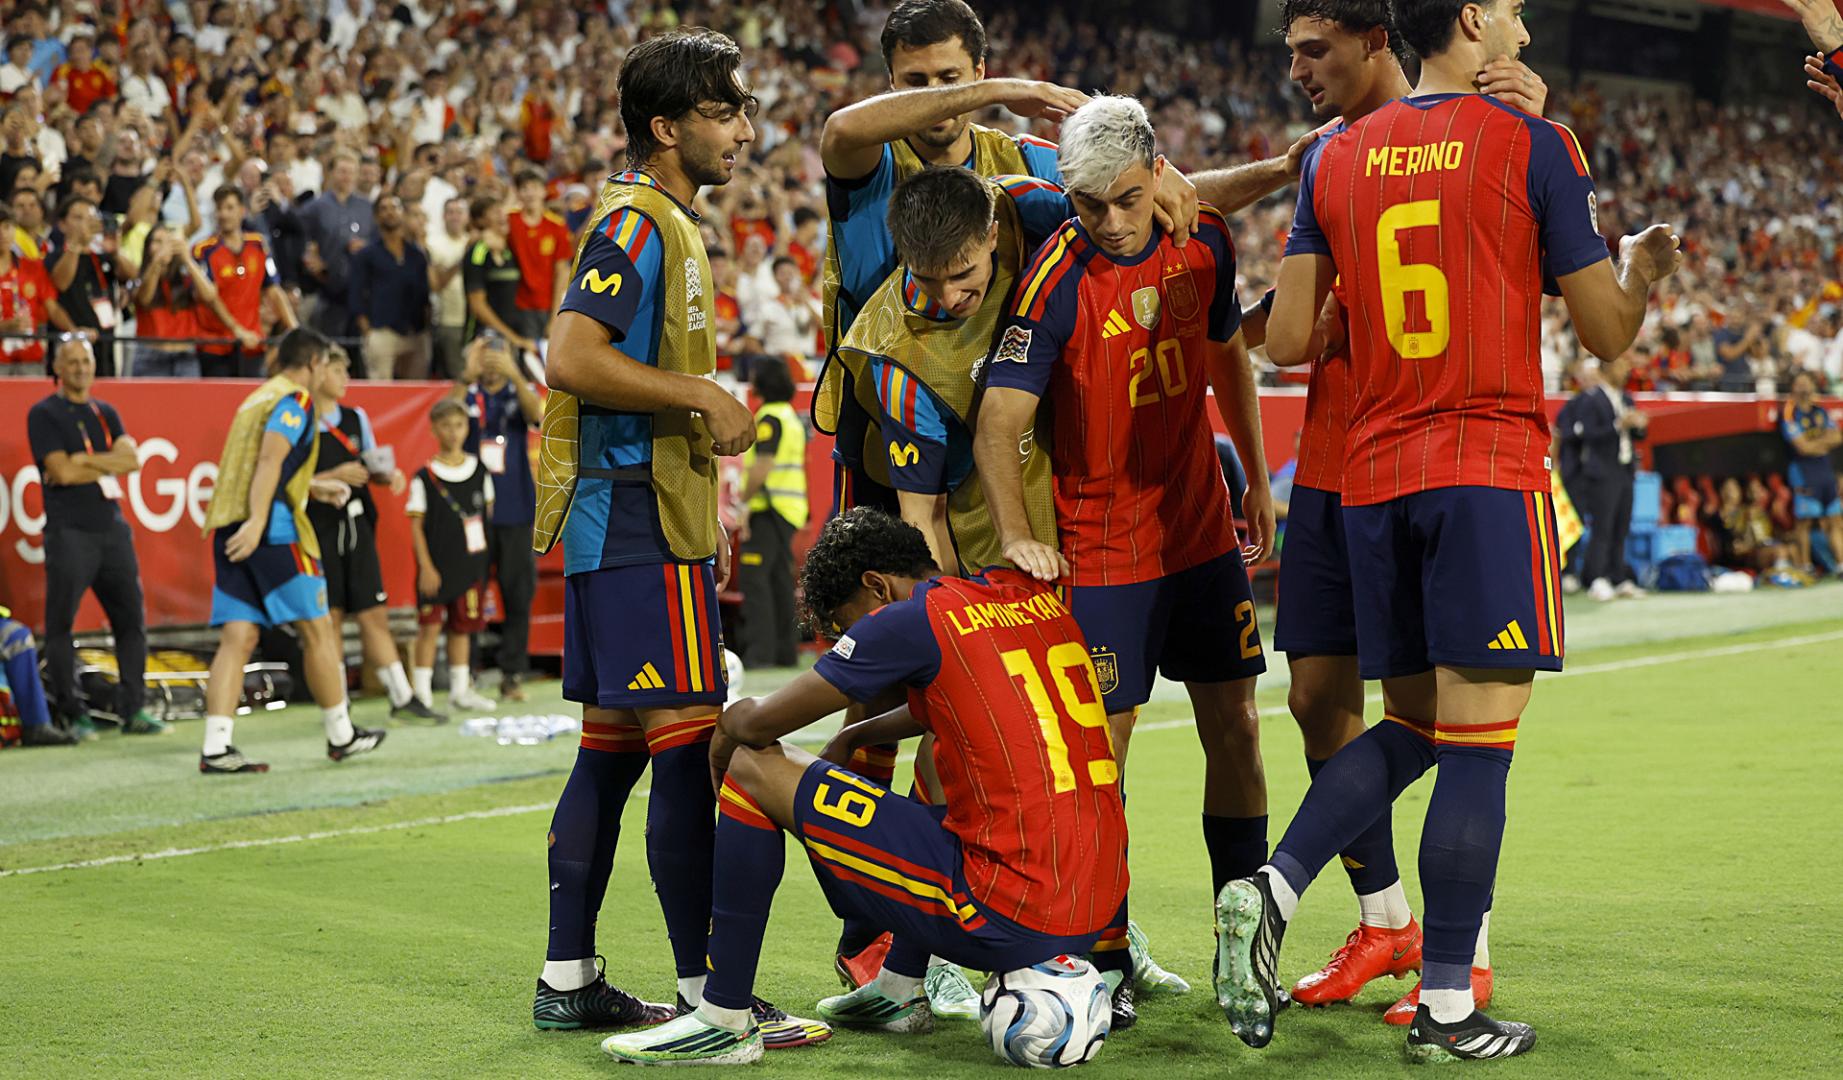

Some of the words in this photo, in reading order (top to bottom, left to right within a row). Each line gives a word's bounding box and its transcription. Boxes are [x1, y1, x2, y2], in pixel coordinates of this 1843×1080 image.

[1365, 141, 1464, 177] MERINO
[1377, 199, 1450, 359] 6
[1129, 338, 1188, 409] 20
[1020, 592, 1070, 621] YAM
[1234, 599, 1262, 660] 2
[1000, 641, 1119, 793] 19
[813, 768, 887, 828] 19
